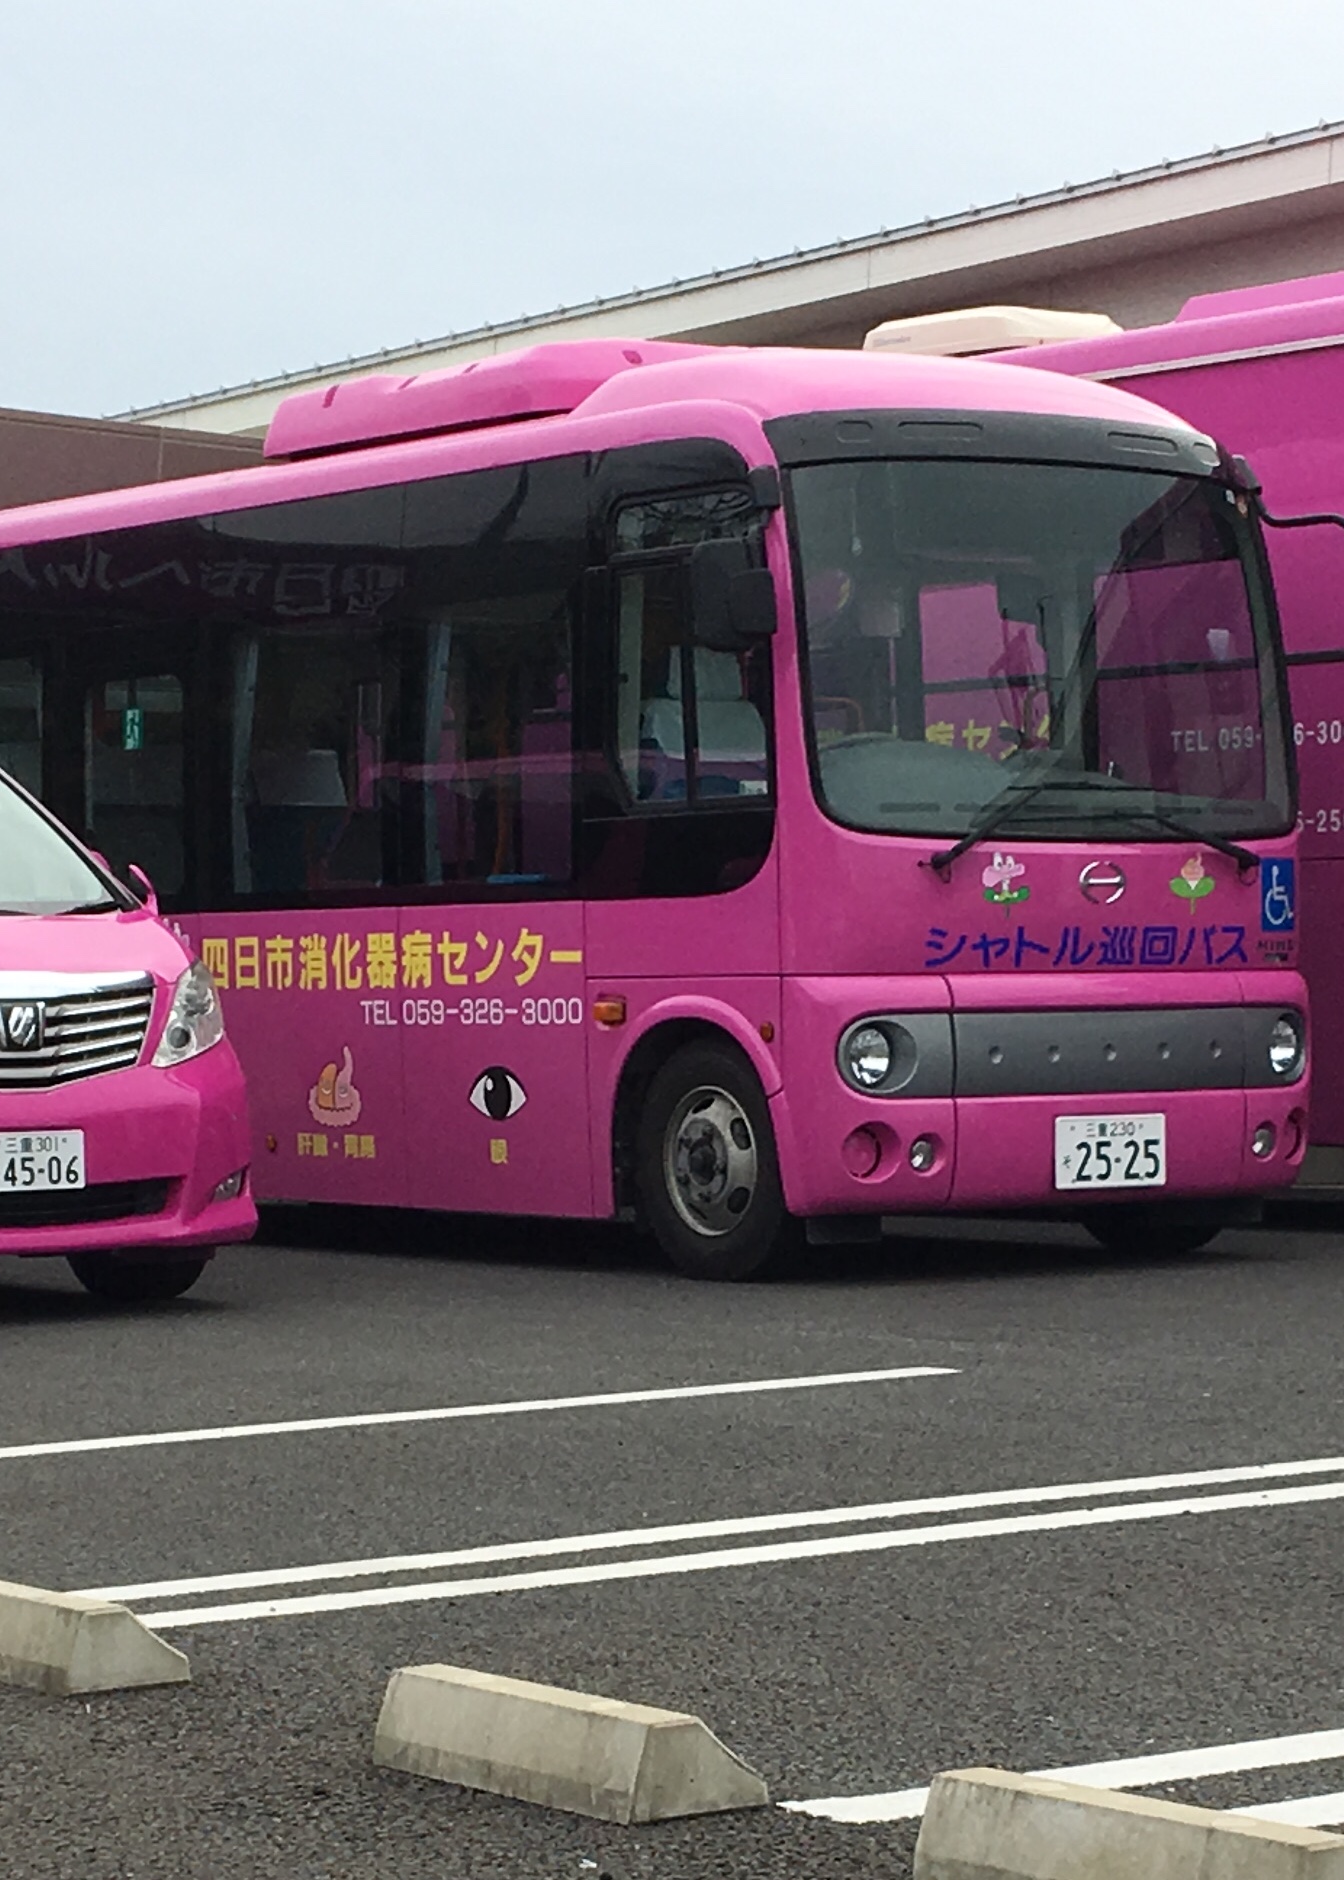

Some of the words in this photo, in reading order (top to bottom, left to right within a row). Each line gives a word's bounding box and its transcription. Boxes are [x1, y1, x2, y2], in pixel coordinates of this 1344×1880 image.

[1170, 730, 1208, 751] TEL
[202, 928, 583, 991] 四日市消化器病センター
[924, 925, 1249, 968] シャトル巡回バス
[360, 1000, 398, 1026] TEL
[402, 998, 583, 1026] 059-326-3000
